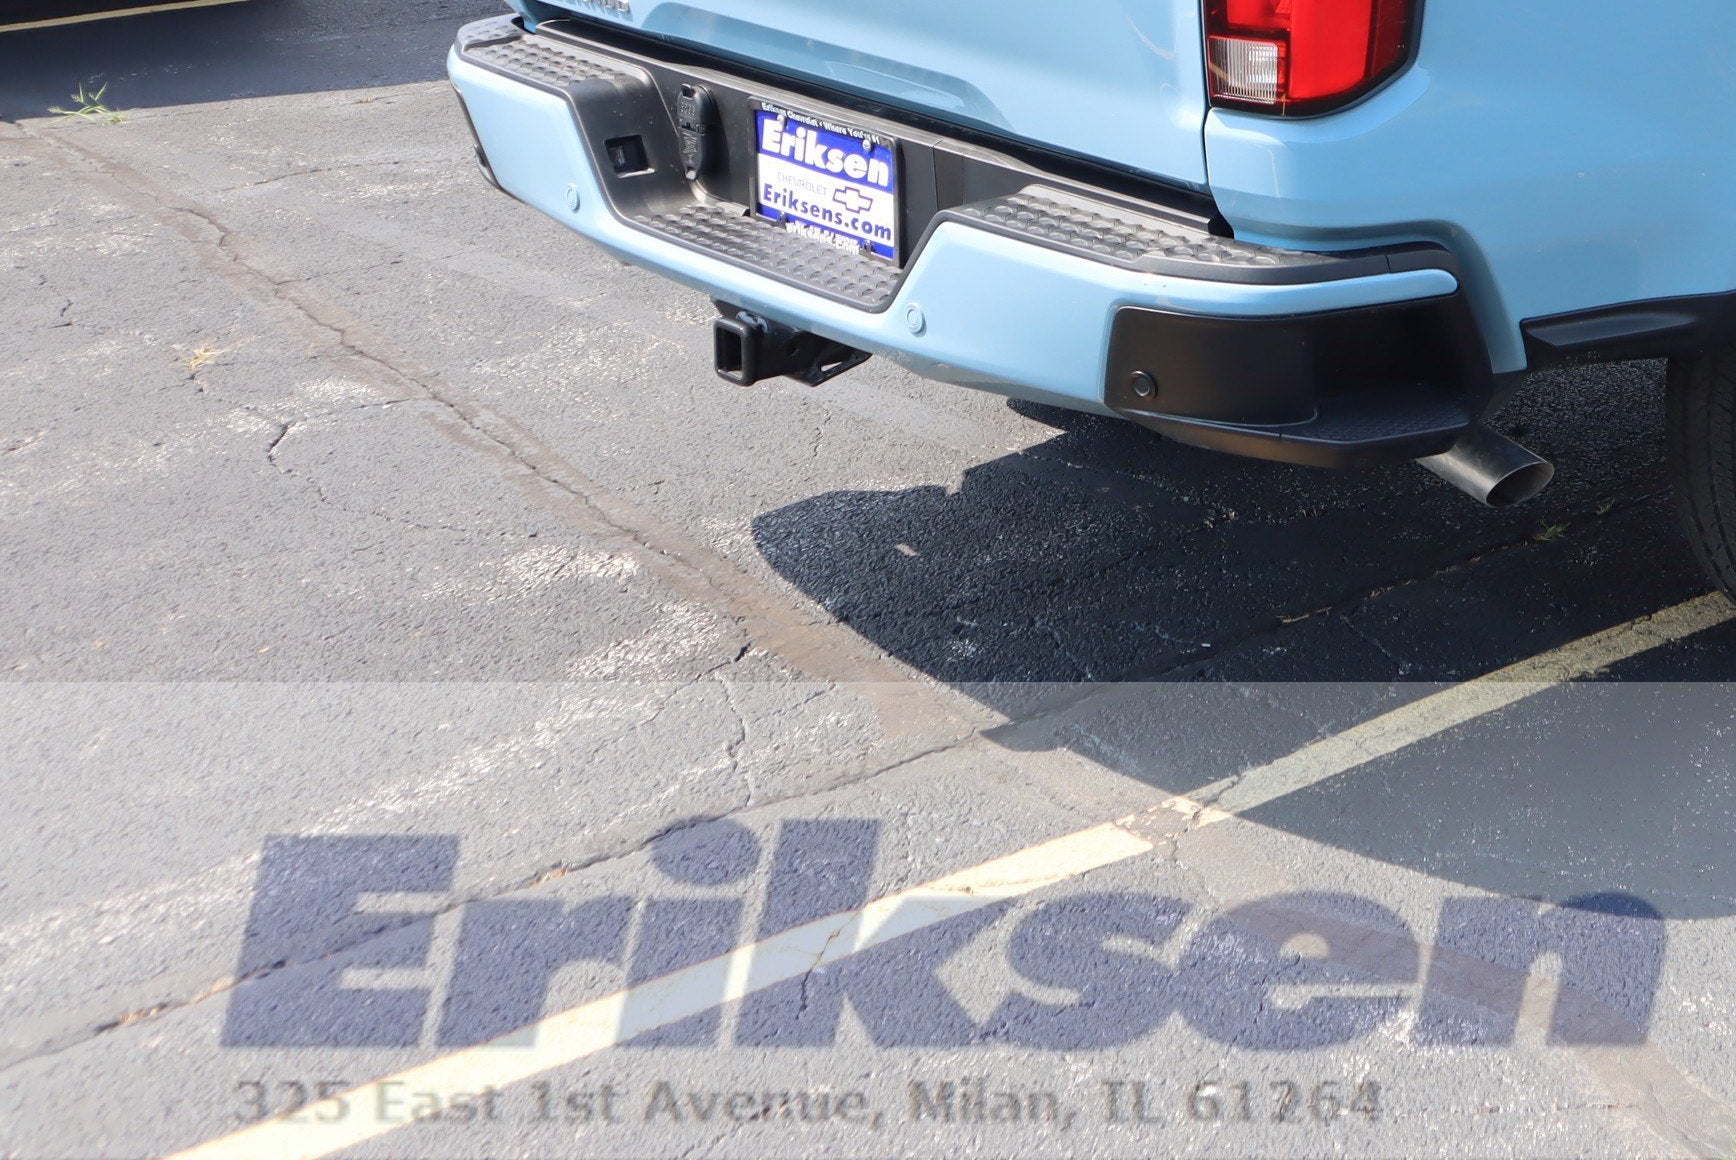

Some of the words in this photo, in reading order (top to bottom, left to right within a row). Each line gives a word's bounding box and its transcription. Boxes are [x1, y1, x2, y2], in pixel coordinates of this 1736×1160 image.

[762, 117, 889, 187] Eriksen
[763, 183, 892, 241] Eriksens.com
[777, 171, 828, 196] CHEVROLET
